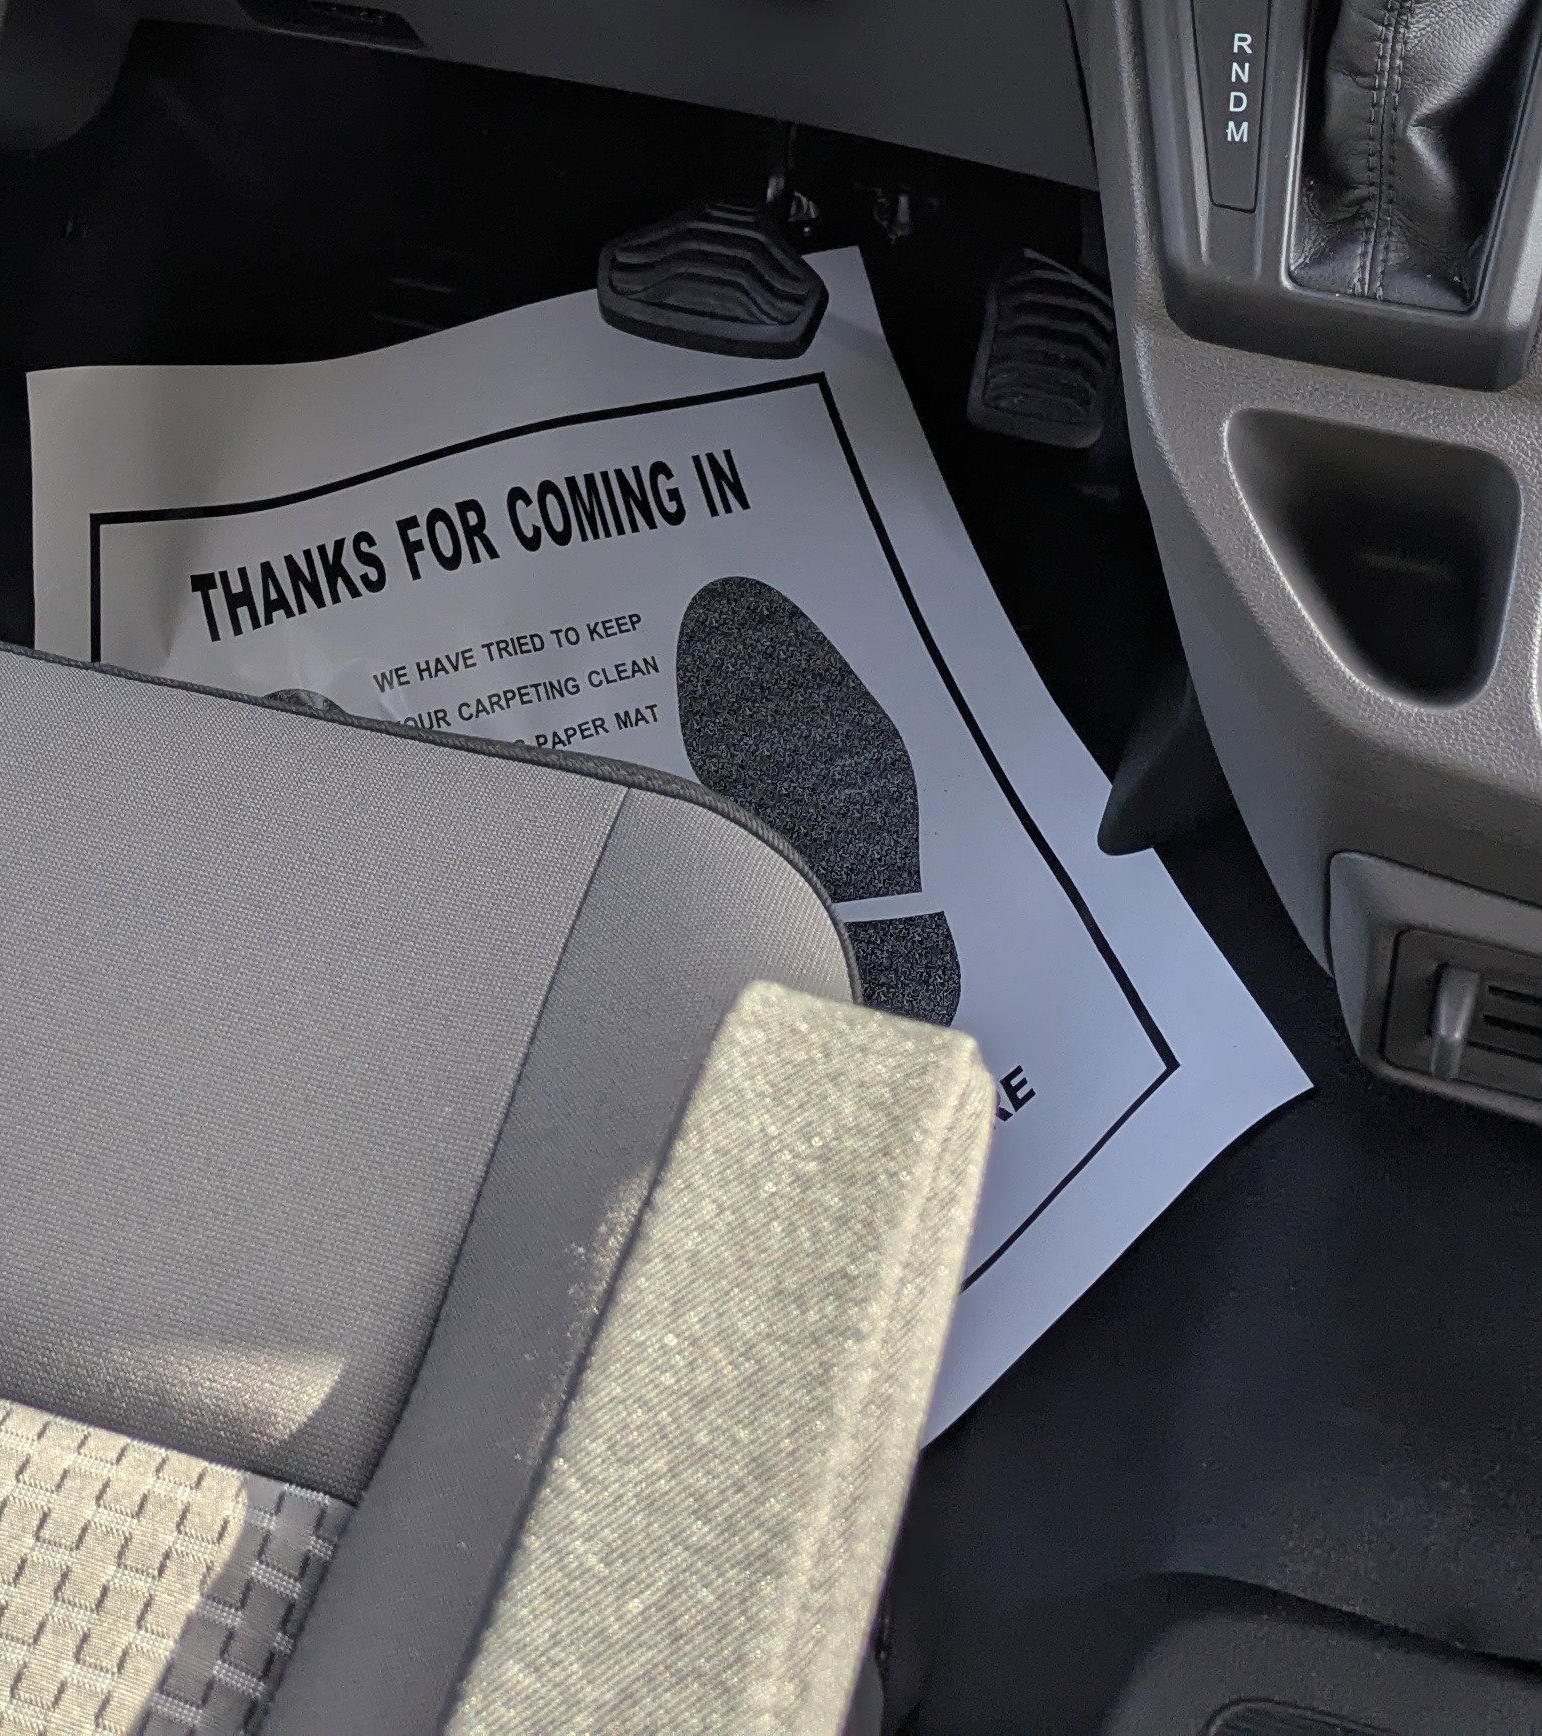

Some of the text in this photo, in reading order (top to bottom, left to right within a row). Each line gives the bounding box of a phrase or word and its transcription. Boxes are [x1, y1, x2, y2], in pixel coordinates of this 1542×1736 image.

[1234, 33, 1253, 54] R
[1232, 63, 1249, 83] N
[1229, 92, 1247, 112] D
[1226, 122, 1248, 143] M
[190, 449, 751, 642] THANKS FOR COMING IN
[373, 613, 642, 693] WE HAVE TRIED TO KEEP
[396, 656, 660, 731] OUR CARPETING CLEAN
[535, 704, 659, 749] PAPER MAT
